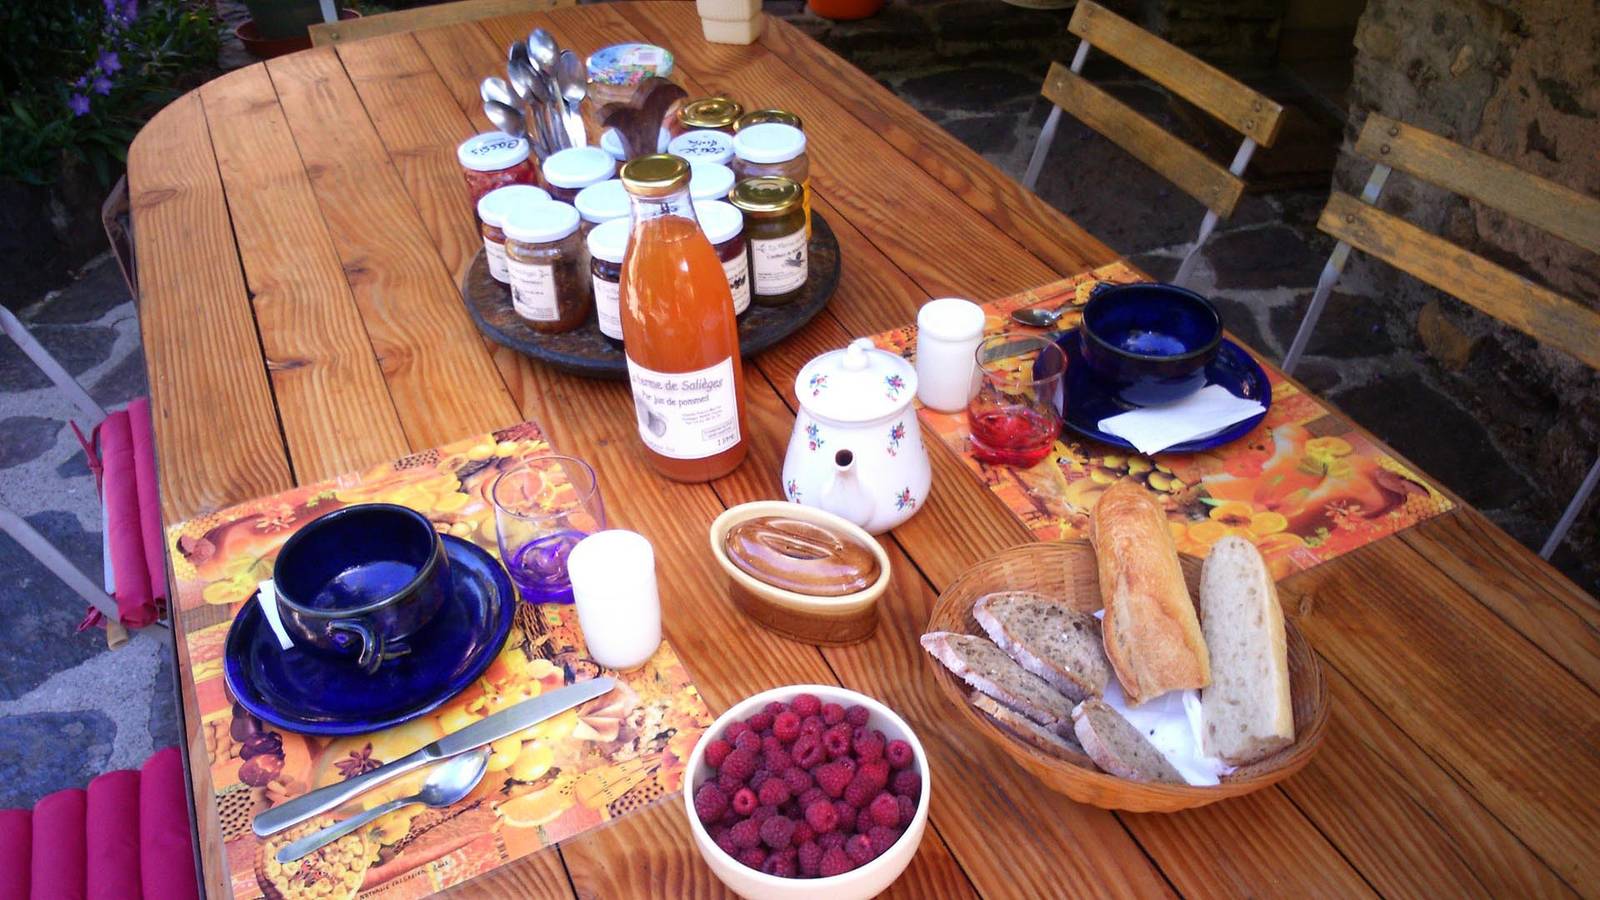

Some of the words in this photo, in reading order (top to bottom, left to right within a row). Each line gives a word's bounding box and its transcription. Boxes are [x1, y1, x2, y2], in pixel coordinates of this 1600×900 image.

[665, 379, 678, 391] de
[681, 377, 723, 392] Salièges
[666, 397, 676, 406] de
